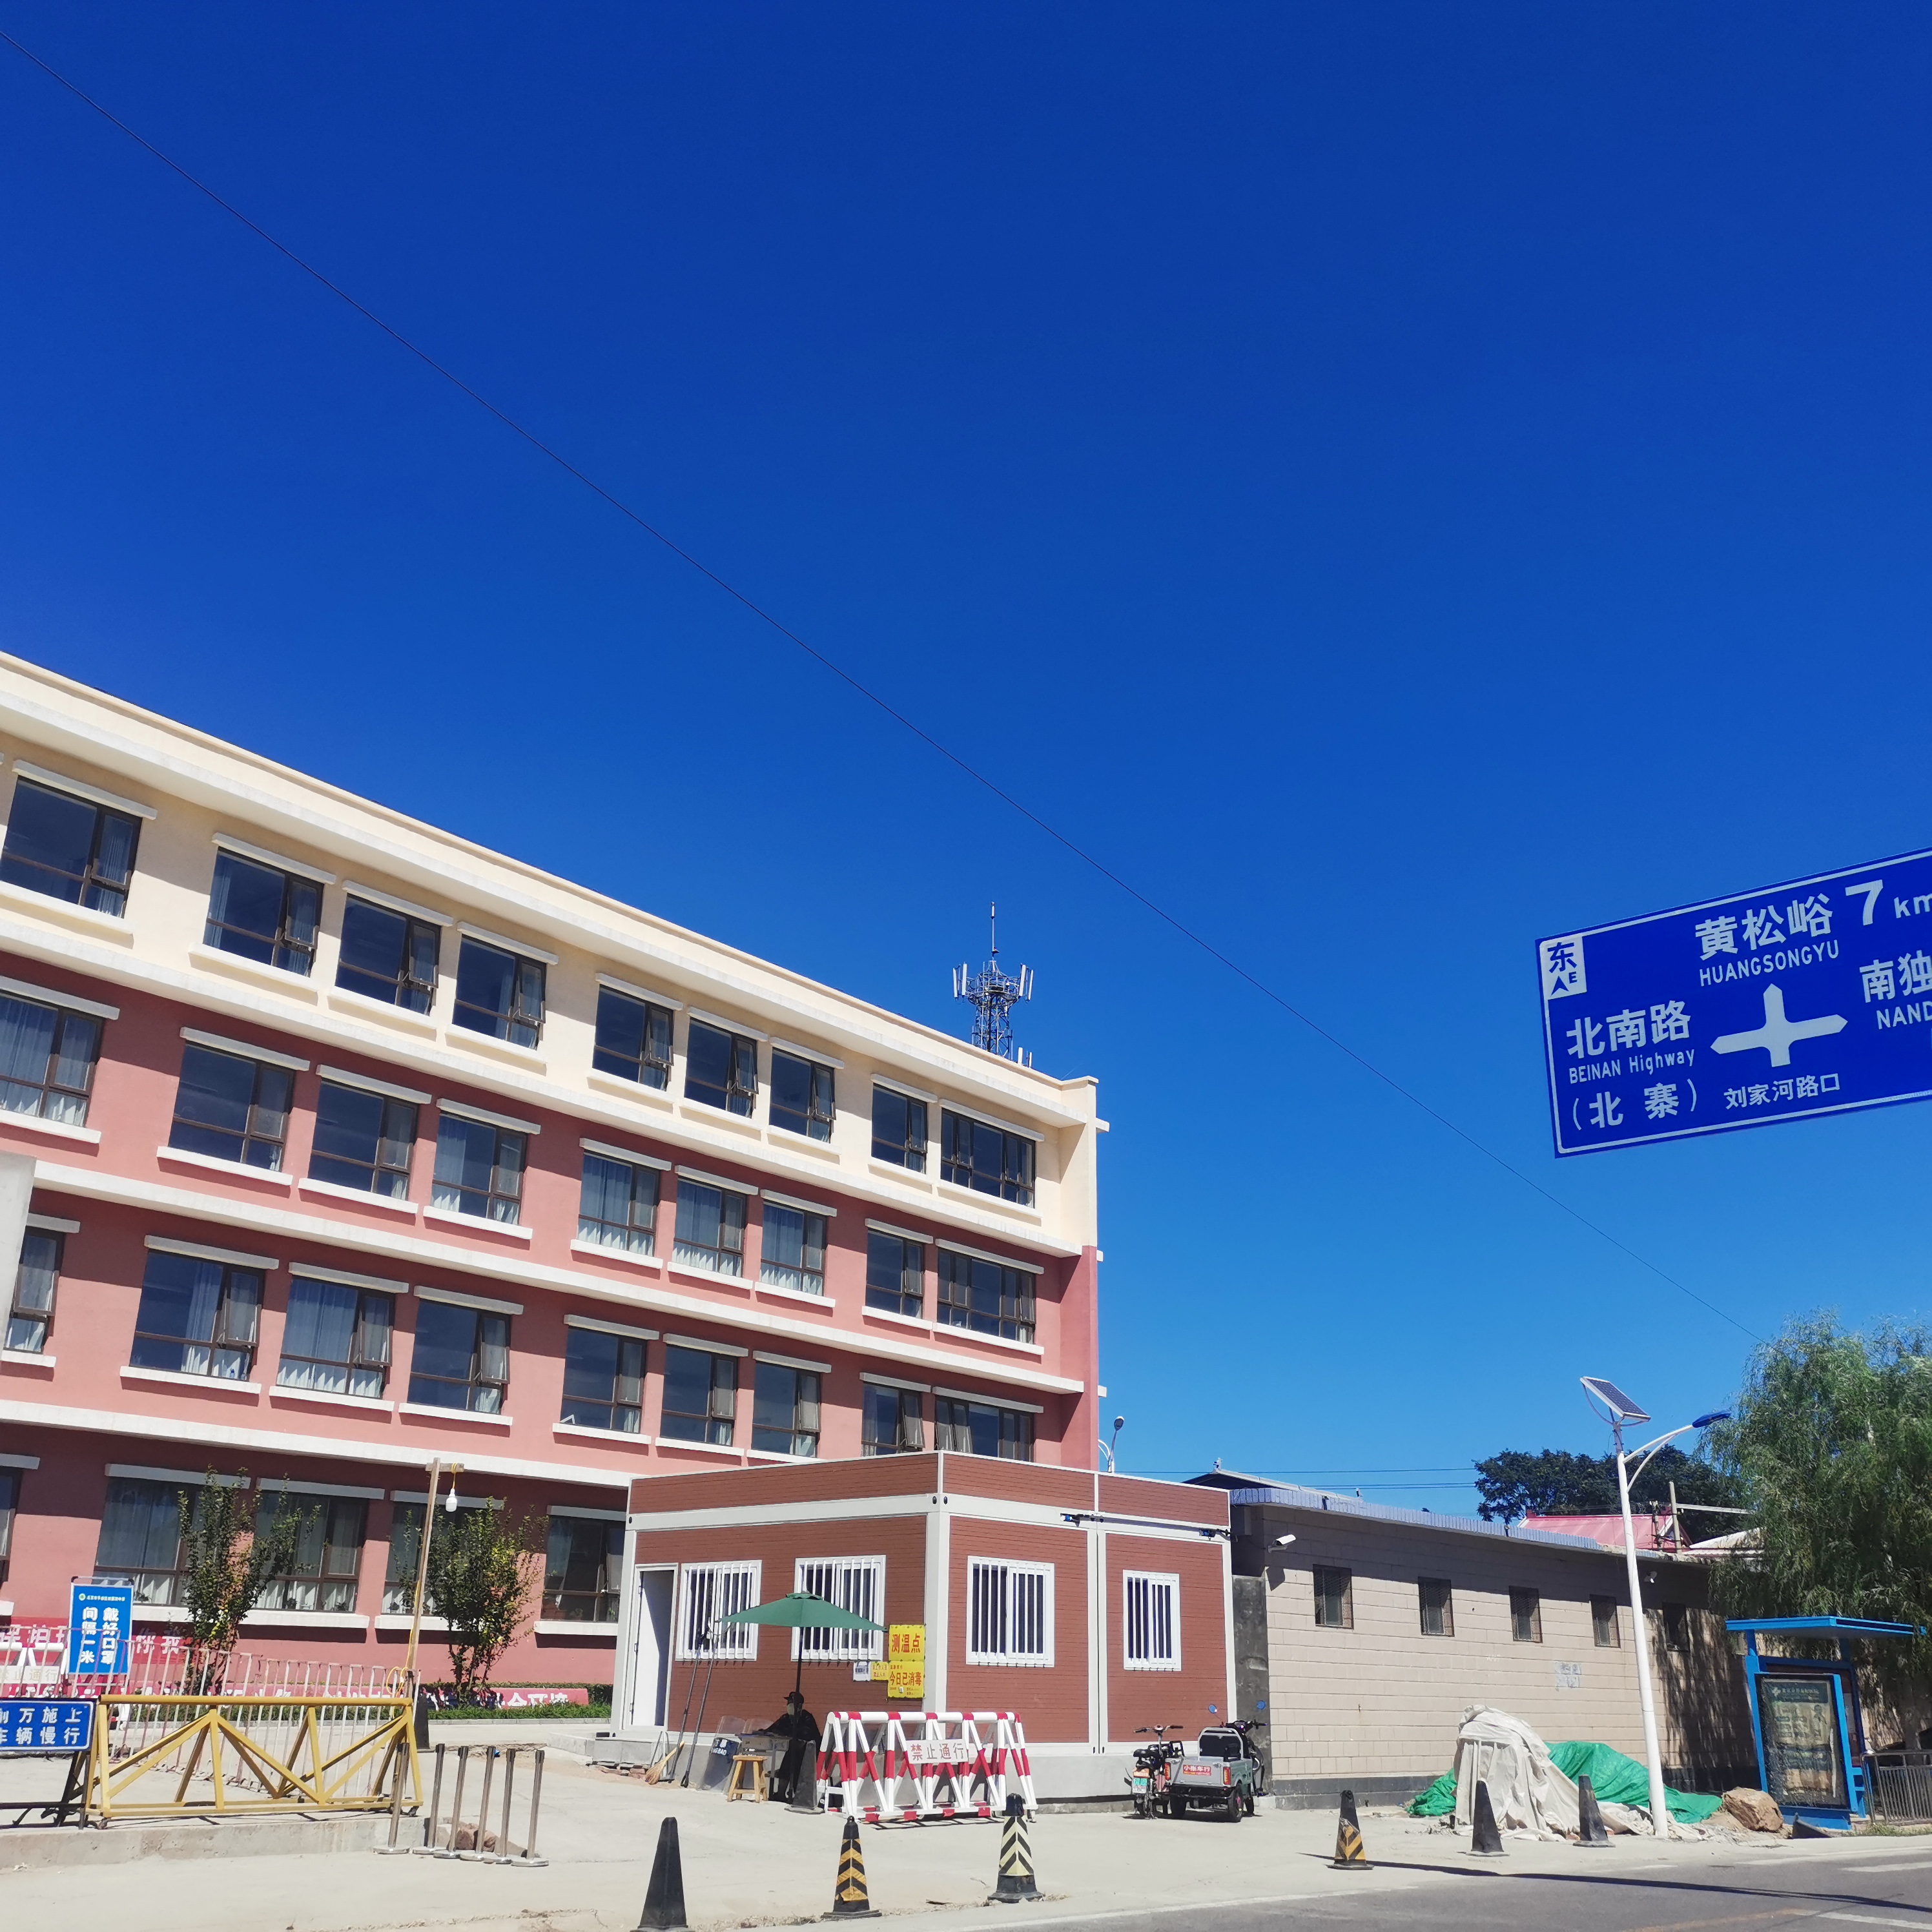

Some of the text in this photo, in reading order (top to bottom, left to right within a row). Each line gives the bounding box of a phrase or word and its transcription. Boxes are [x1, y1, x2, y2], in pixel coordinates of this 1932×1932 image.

[1695, 879, 1932, 961] 黄松峪 7 km
[1547, 941, 1577, 973] 东
[1699, 940, 1839, 987] HUANGSONGYU
[1568, 971, 1577, 984] E
[1566, 1000, 1691, 1059] 北南路
[1569, 1049, 1695, 1084] BEINAN Highway
[1723, 1073, 1840, 1110] 刘家河路口
[80, 1606, 99, 1664] 间隔一米
[101, 1607, 119, 1665] 戴好口罩
[891, 1632, 921, 1654] 测温点
[889, 1671, 922, 1687] 今日已消毒
[910, 1743, 964, 1761] 禁止通行
